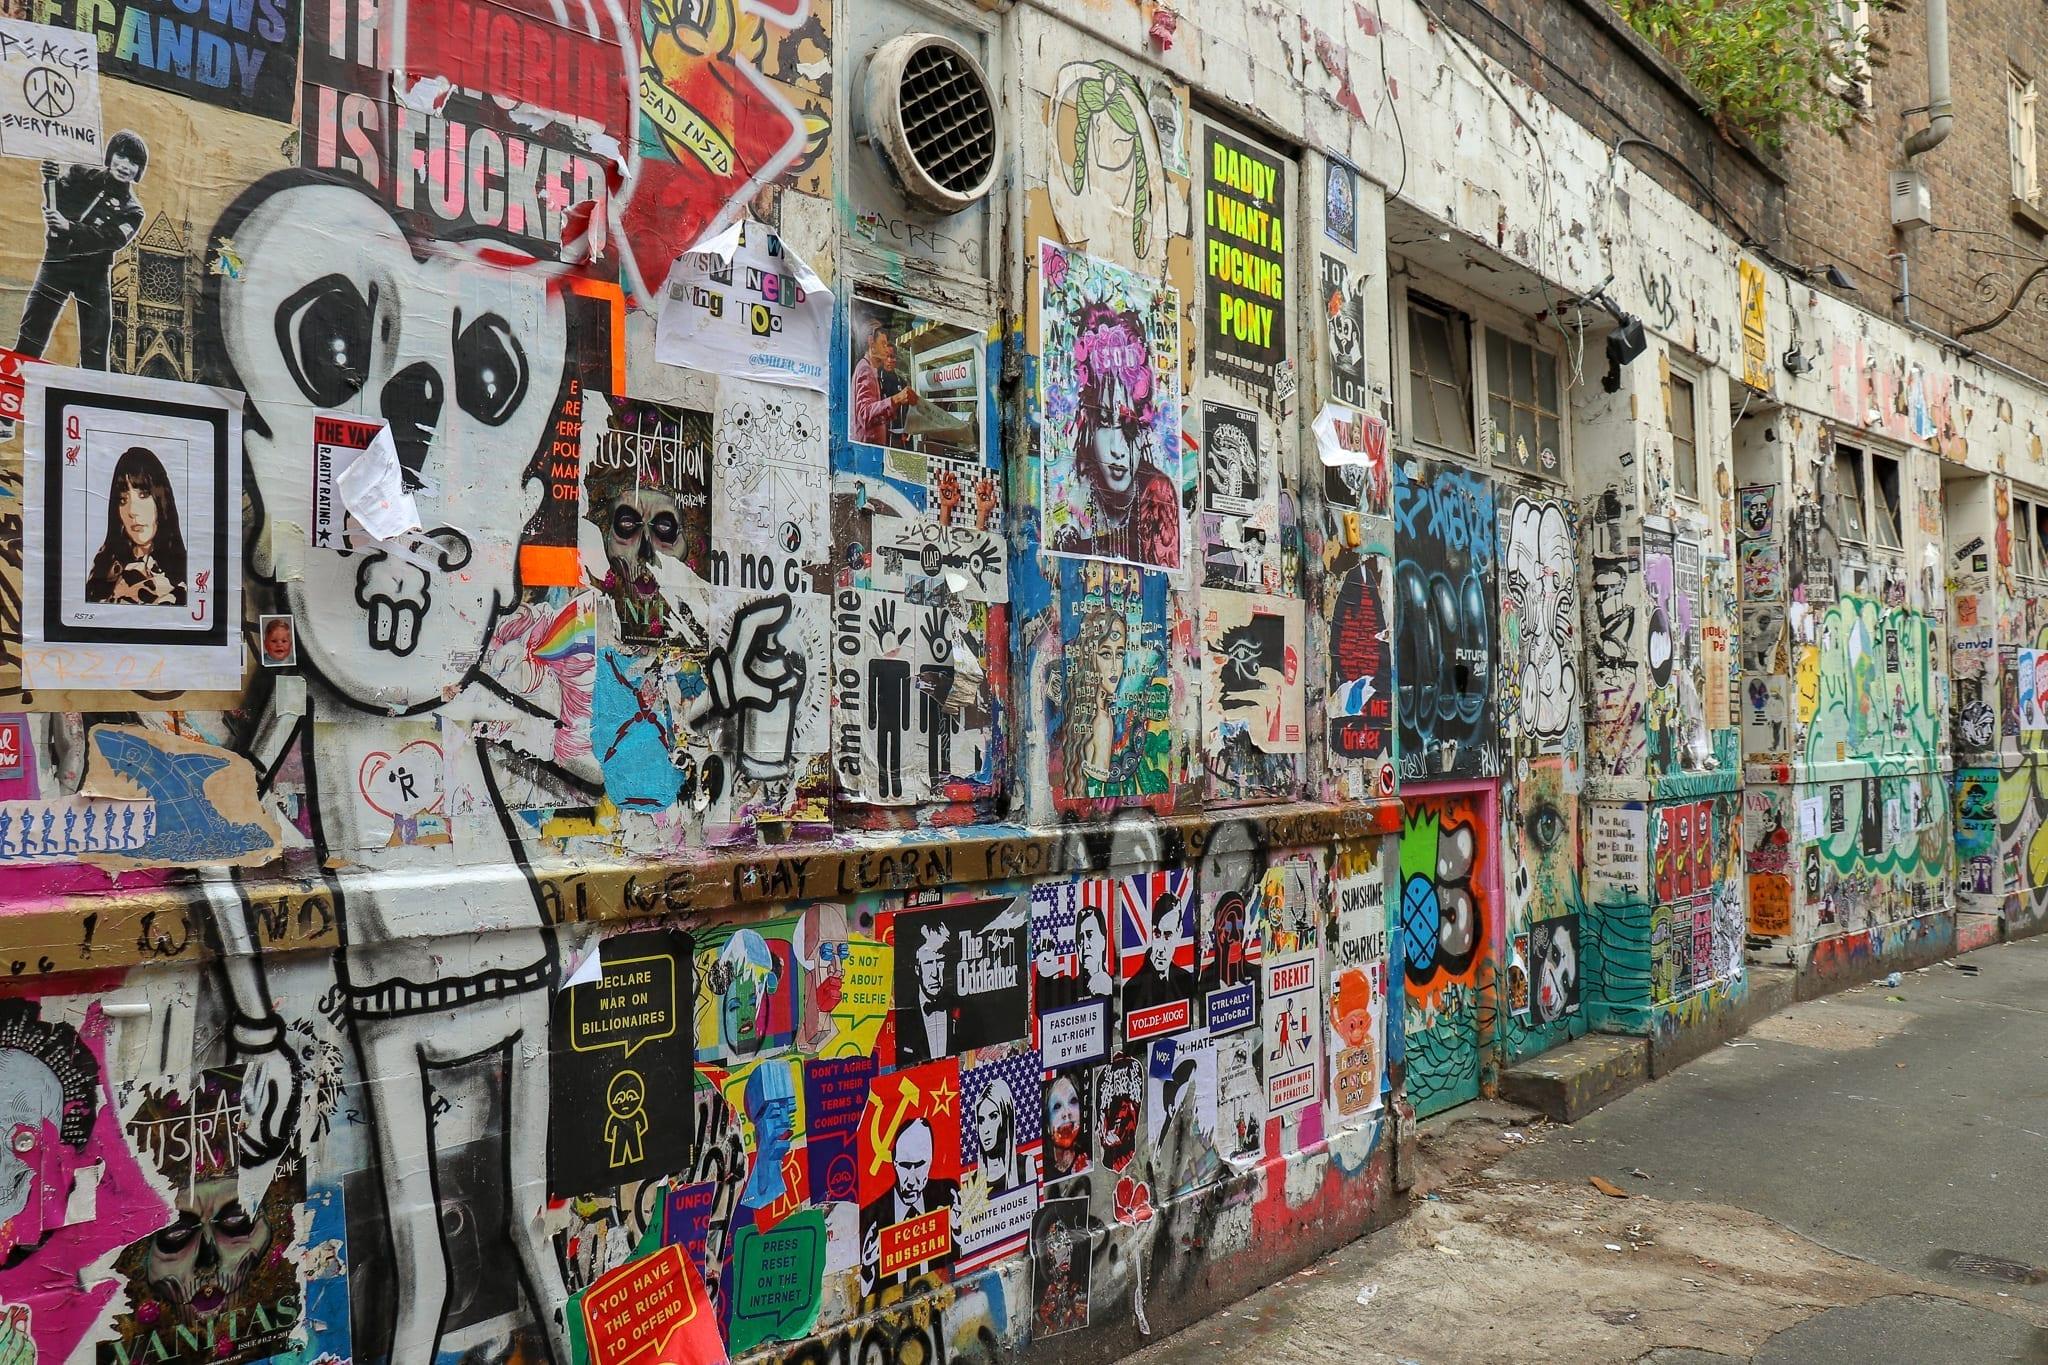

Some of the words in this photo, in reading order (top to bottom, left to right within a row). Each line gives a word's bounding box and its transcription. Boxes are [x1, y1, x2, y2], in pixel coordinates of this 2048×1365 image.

[1, 32, 90, 79] PEACE
[640, 79, 677, 124] DEAD
[1, 112, 95, 146] EVERYTHING
[317, 86, 380, 190] IS
[1213, 142, 1277, 204] DADDY
[1206, 189, 1215, 226] I
[1217, 194, 1270, 247] WANT
[1270, 218, 1284, 254] A
[1208, 239, 1283, 300] FUCKING
[1219, 293, 1274, 349] PONY
[561, 401, 580, 416] RE
[317, 421, 343, 442] THE
[319, 446, 331, 486] RARITY
[319, 488, 331, 525] RATING
[675, 493, 708, 510] MAGAZINE
[741, 554, 774, 590] no
[923, 551, 940, 567] UAP
[839, 588, 862, 657] one
[838, 668, 862, 711] no
[1371, 700, 1388, 717] ME
[838, 724, 862, 777] am
[733, 852, 812, 902] MAY
[836, 845, 952, 898] LEARN
[958, 930, 983, 962] The
[1342, 931, 1384, 966] SPARKLE
[858, 957, 879, 967] NOT
[596, 970, 652, 990] DECLARE
[850, 975, 883, 986] ABOUT
[956, 963, 1019, 997] Oddfather
[1273, 965, 1310, 992] BREXIT
[600, 997, 625, 1011] WAR
[631, 993, 648, 1006] ON
[853, 993, 886, 1005] SELFIE
[1211, 995, 1251, 1011] CTRL+ALT+
[582, 1010, 666, 1035] BILLIONAIRES
[1050, 1015, 1087, 1030] FASCISM
[1089, 1011, 1097, 1022] IS
[1132, 1009, 1184, 1031] VOLDE-MOGG
[1051, 1026, 1096, 1045] ALT-RIGHT
[1061, 1048, 1073, 1058] BY
[1075, 1043, 1088, 1055] ME
[811, 1065, 840, 1079] DON'T
[843, 1060, 873, 1073] AGREE
[1272, 1077, 1296, 1092] GERMANY
[1297, 1069, 1311, 1084] WINS
[821, 1083, 834, 1094] TO
[838, 1078, 863, 1090] THEIR
[1275, 1094, 1285, 1104] ON
[821, 1098, 851, 1111] TERMS
[971, 1206, 999, 1225] WHITE
[1000, 1196, 1028, 1212] HOUSE
[964, 1224, 1006, 1245] CLOTHING
[1008, 1209, 1036, 1229] RANGE
[762, 1238, 799, 1252] PRESS
[886, 1234, 946, 1268] RUSSIAN
[761, 1257, 797, 1271] RESET
[599, 1284, 629, 1316] YOU
[633, 1260, 671, 1293] HAVE
[757, 1277, 773, 1288] ON
[778, 1273, 798, 1286] THE
[603, 1310, 632, 1336] THE
[636, 1279, 675, 1313] RIGHT
[750, 1289, 802, 1308] INTERNET
[606, 1334, 627, 1358] TO
[632, 1299, 683, 1341] OFFEND
